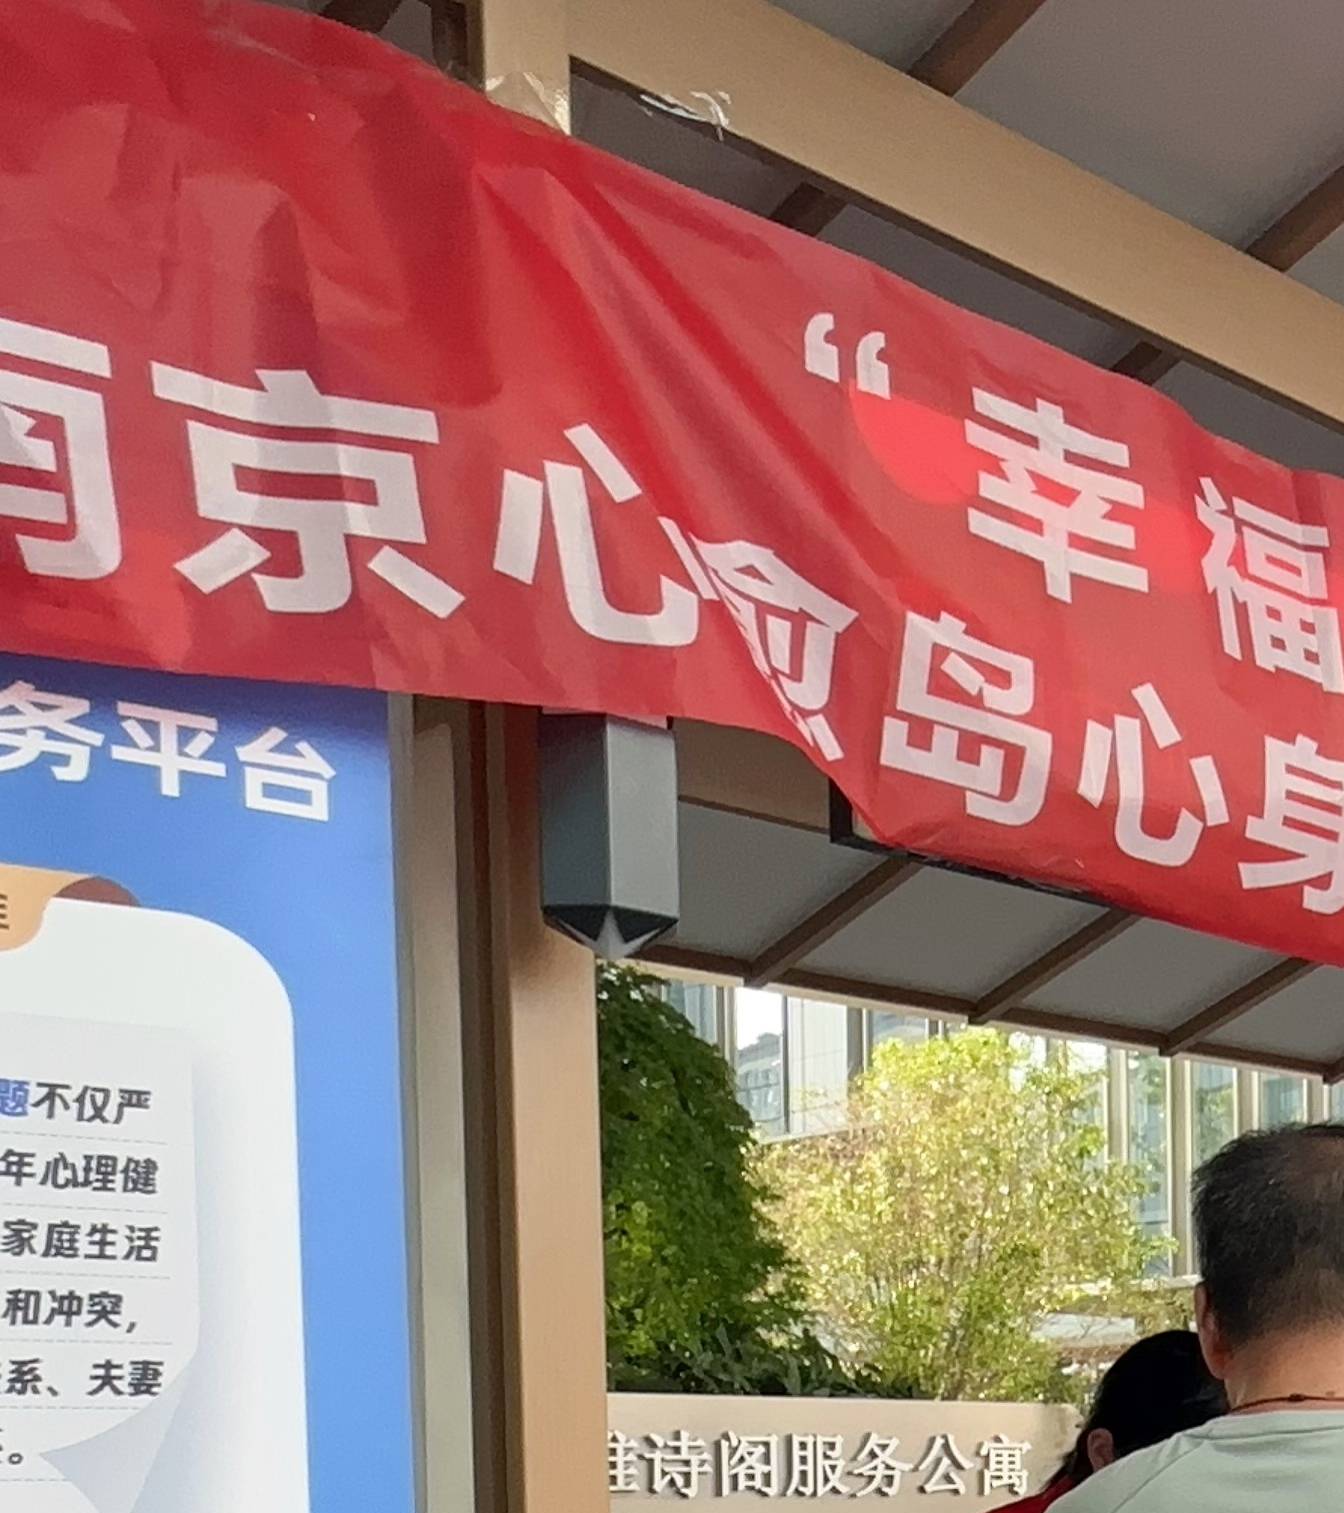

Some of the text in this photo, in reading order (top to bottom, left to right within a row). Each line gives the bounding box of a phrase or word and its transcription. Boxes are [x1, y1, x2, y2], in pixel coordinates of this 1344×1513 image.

[0, 682, 335, 822] 务平台
[0, 1078, 152, 1126] 题不仅严
[0, 1148, 159, 1195] 年心理健
[1, 1218, 161, 1263] 家庭生活
